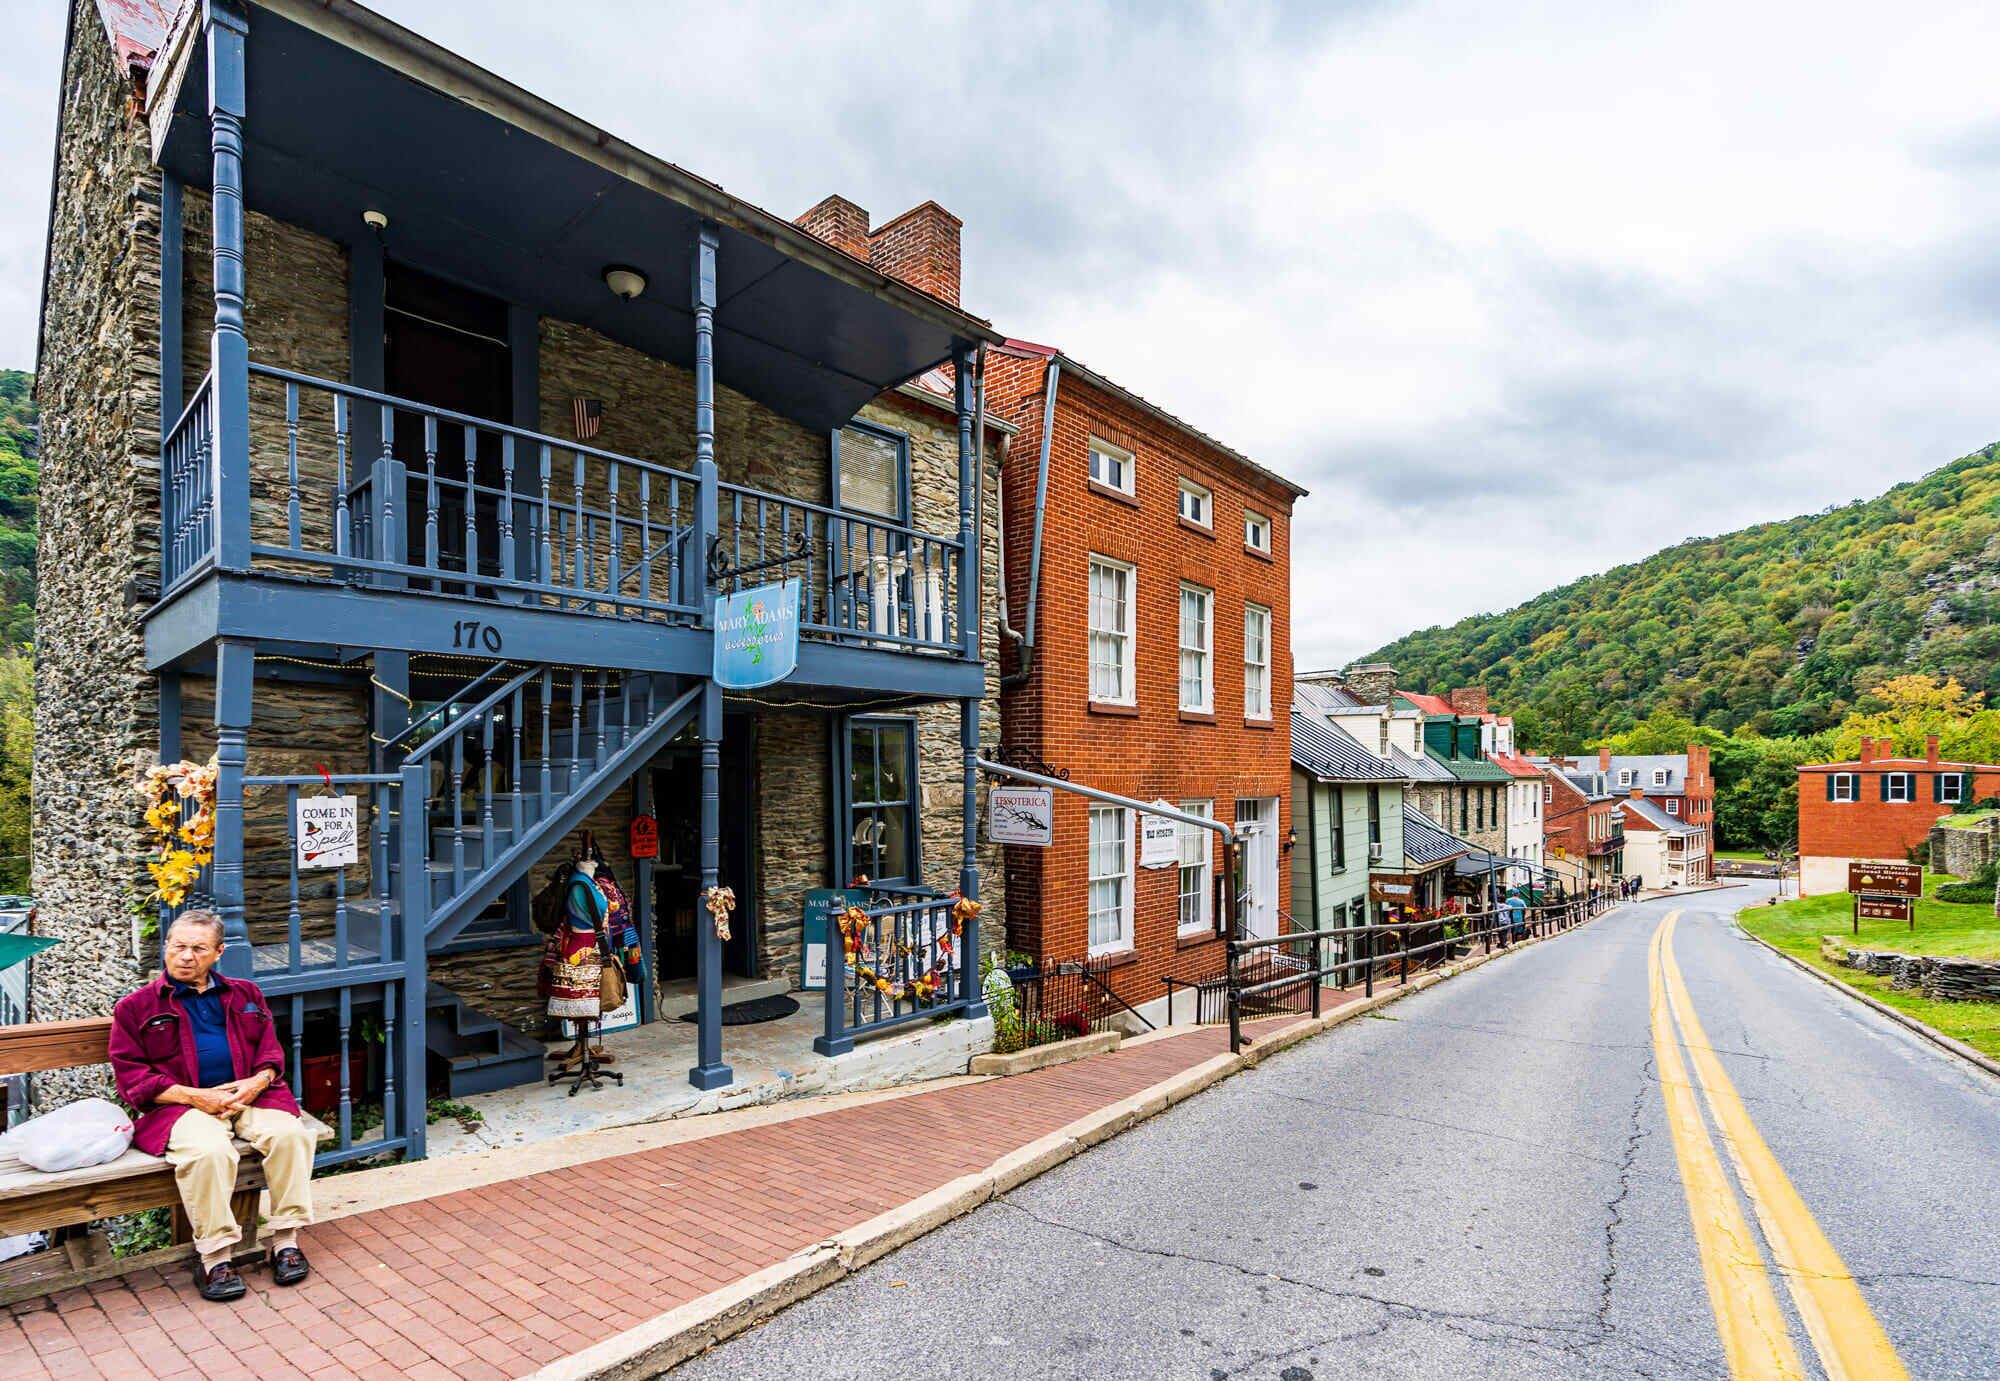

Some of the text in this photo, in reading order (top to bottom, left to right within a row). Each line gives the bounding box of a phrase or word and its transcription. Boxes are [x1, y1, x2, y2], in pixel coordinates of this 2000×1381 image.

[719, 607, 794, 633] MARY ADAMS
[453, 620, 502, 653] 170
[303, 807, 353, 818] COME IN
[324, 821, 353, 830] FOR A
[301, 830, 354, 852] Spell
[808, 900, 830, 908] MAR
